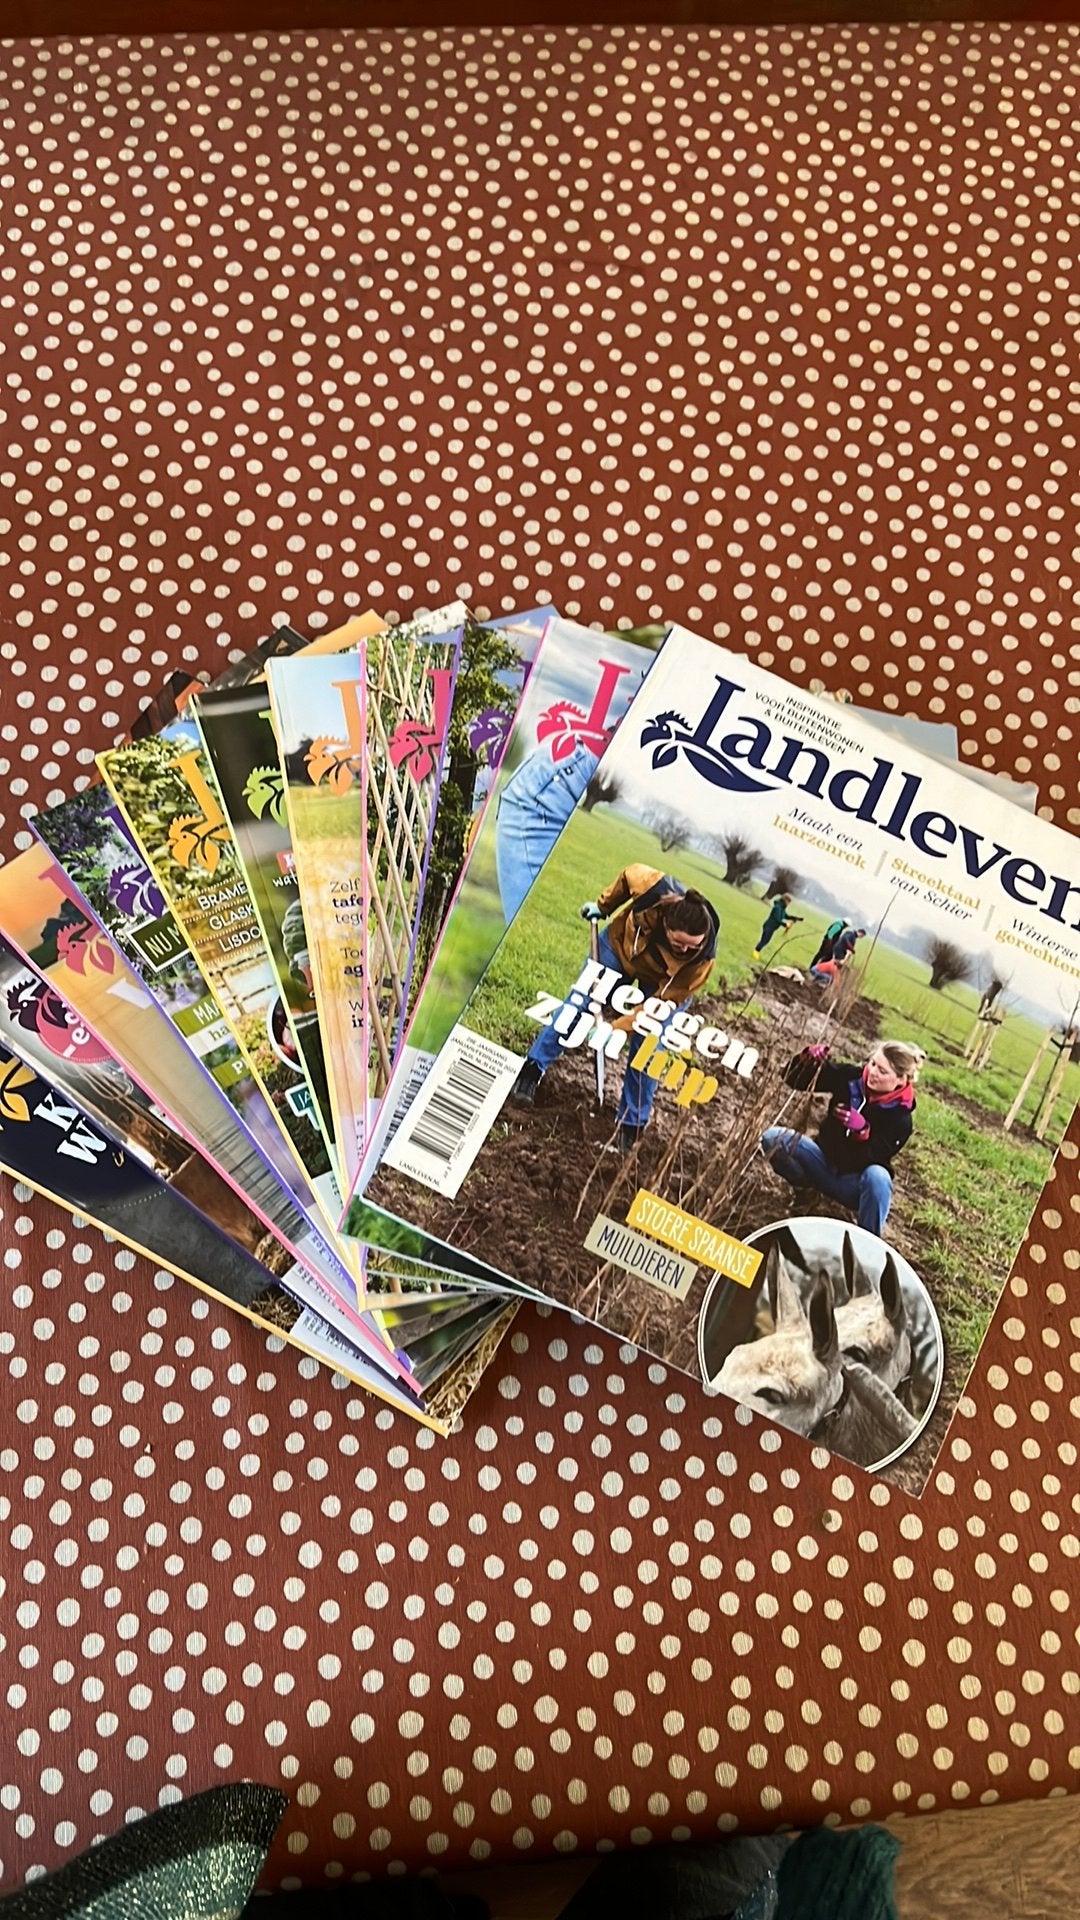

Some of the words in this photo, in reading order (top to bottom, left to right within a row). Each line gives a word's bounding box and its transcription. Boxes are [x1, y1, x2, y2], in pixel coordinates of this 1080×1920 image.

[755, 691, 785, 713] VOOR
[787, 706, 865, 753] BUITENWONEN
[764, 709, 772, 719] &
[774, 713, 847, 755] BUITENLEVEN
[786, 696, 842, 730] INSPIRATIE
[772, 814, 866, 870] laarzenrek
[788, 806, 834, 837] Maak
[836, 831, 864, 852] een
[329, 878, 361, 894] Zelf
[889, 874, 919, 896] van
[923, 890, 974, 922] Schier
[891, 856, 982, 911] Streektaal
[145, 931, 173, 959] NU
[1011, 915, 1080, 962] Winterse
[572, 958, 760, 1079] Heggen
[524, 991, 628, 1061] zijn
[630, 1033, 719, 1109] hip
[596, 1225, 686, 1291] MUILDIEREN
[636, 1198, 693, 1246] STOERE
[688, 1226, 756, 1281] SPAANSE
